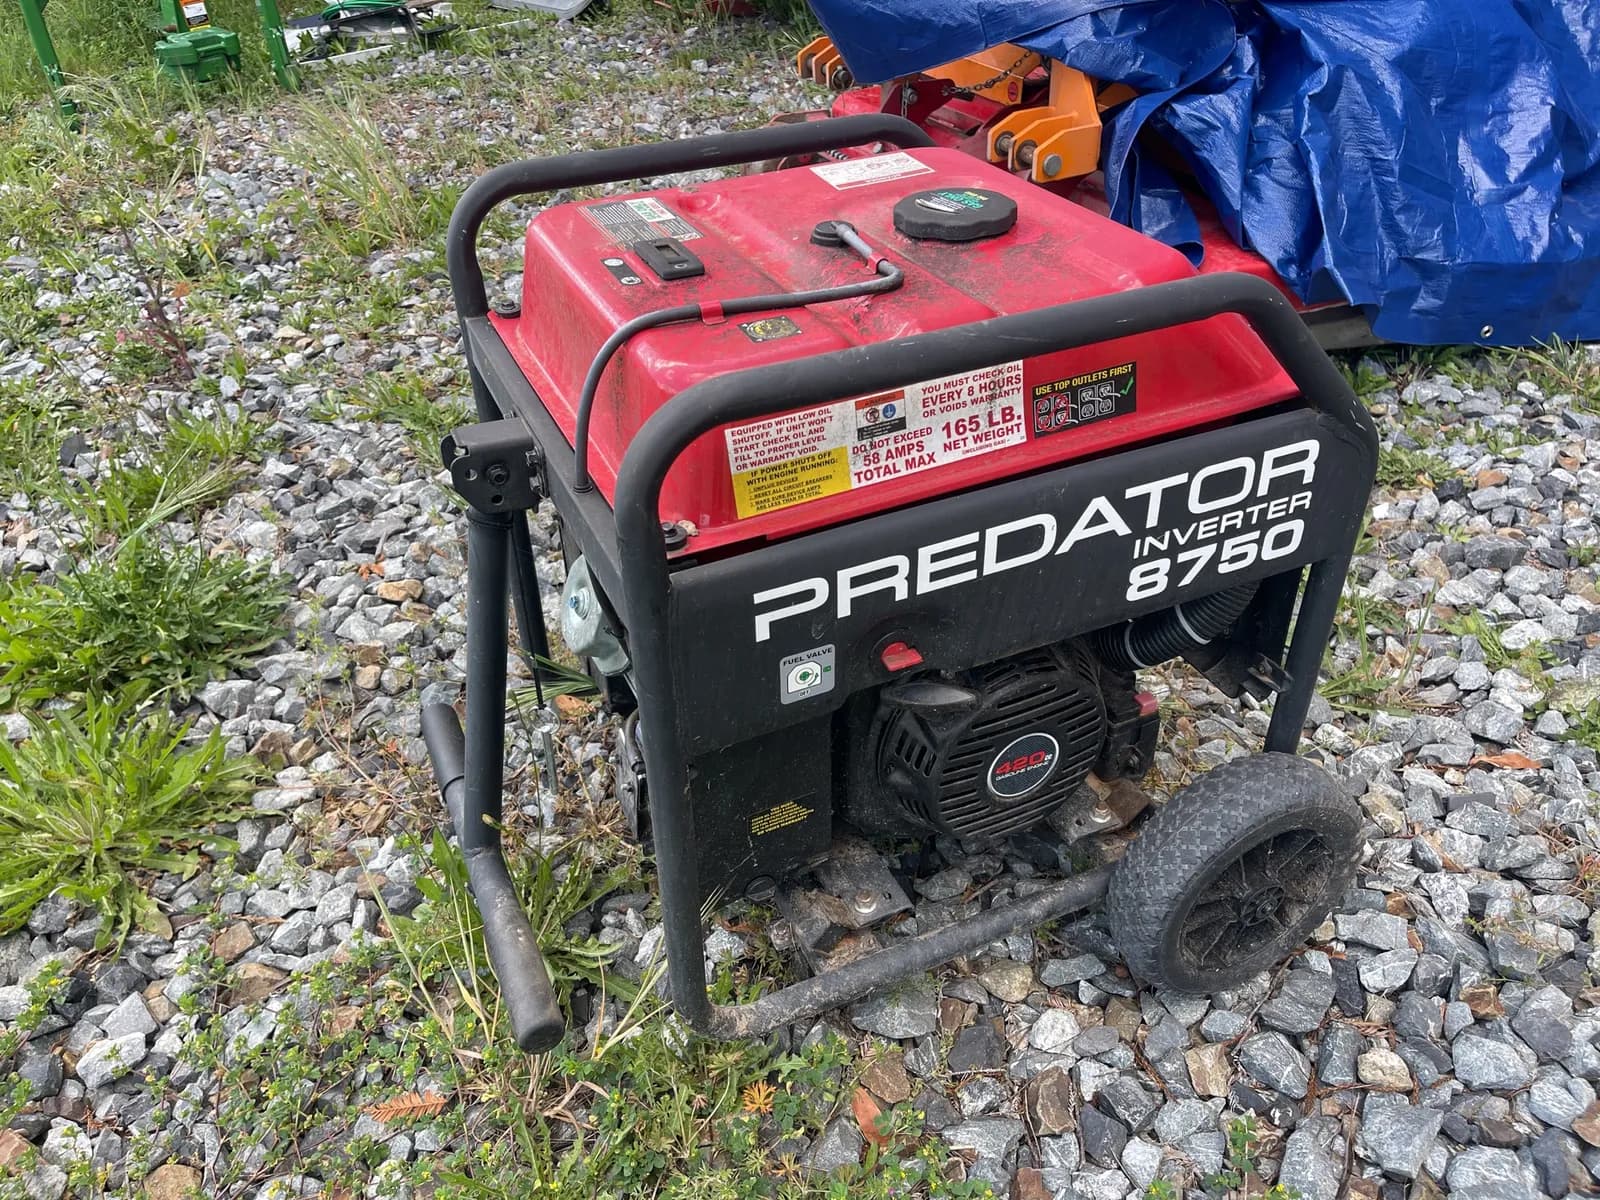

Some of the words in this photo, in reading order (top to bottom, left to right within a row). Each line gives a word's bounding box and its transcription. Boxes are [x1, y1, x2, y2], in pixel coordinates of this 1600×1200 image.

[922, 384, 941, 395] YOU
[943, 377, 970, 390] MUST
[972, 369, 1004, 382] CHECK
[1006, 363, 1022, 374] OIL
[922, 389, 963, 408] EVERY
[967, 386, 975, 396] 8
[979, 374, 1022, 394] HOURS
[1035, 385, 1052, 396] USE
[1054, 380, 1070, 391] TOP
[1072, 370, 1108, 387] OUTLETS
[1110, 364, 1133, 377] FIRST
[922, 409, 936, 418] OR
[939, 401, 967, 414] VOIDS
[971, 386, 1022, 406] WARRANTY
[731, 422, 773, 437] EQUIPPED
[775, 416, 796, 427] WITH
[798, 411, 816, 421] LOW
[818, 408, 832, 416] OIL
[732, 431, 772, 446] SHUTOFF.
[786, 422, 805, 433] UNIT
[808, 415, 833, 427] WON'T
[942, 415, 981, 439] 165
[987, 405, 1022, 428] LB.
[733, 443, 759, 455] START
[762, 435, 790, 447] CHECK
[793, 431, 807, 440] OIL
[808, 426, 825, 436] AND
[734, 453, 753, 463] FILL
[755, 449, 766, 458] TO
[768, 441, 800, 454] PROPER
[802, 435, 827, 446] LEVEL
[852, 444, 867, 455] DO
[870, 435, 892, 451] NOT
[894, 427, 933, 444] EXCEED
[943, 437, 968, 452] NET
[972, 423, 1023, 445] WEIGHT
[736, 464, 748, 472] OR
[750, 451, 796, 468] WARRANTY
[796, 445, 819, 457] VOID.
[750, 470, 758, 478] IF
[760, 462, 788, 475] POWER
[790, 455, 816, 467] SHUTS
[818, 451, 832, 460] OFF
[854, 463, 901, 484] TOTAL
[905, 452, 936, 470] MAX
[863, 452, 880, 467] 58
[885, 441, 925, 460] AMPS
[746, 476, 767, 486] WITH
[769, 466, 798, 481] ENGINE
[800, 457, 839, 472] RUNNING:
[1133, 491, 1314, 560] INVERTER
[753, 439, 1321, 644] PREDATOR
[1125, 519, 1306, 603] 8750
[783, 656, 805, 667] FUEL
[806, 647, 833, 659] VALVE
